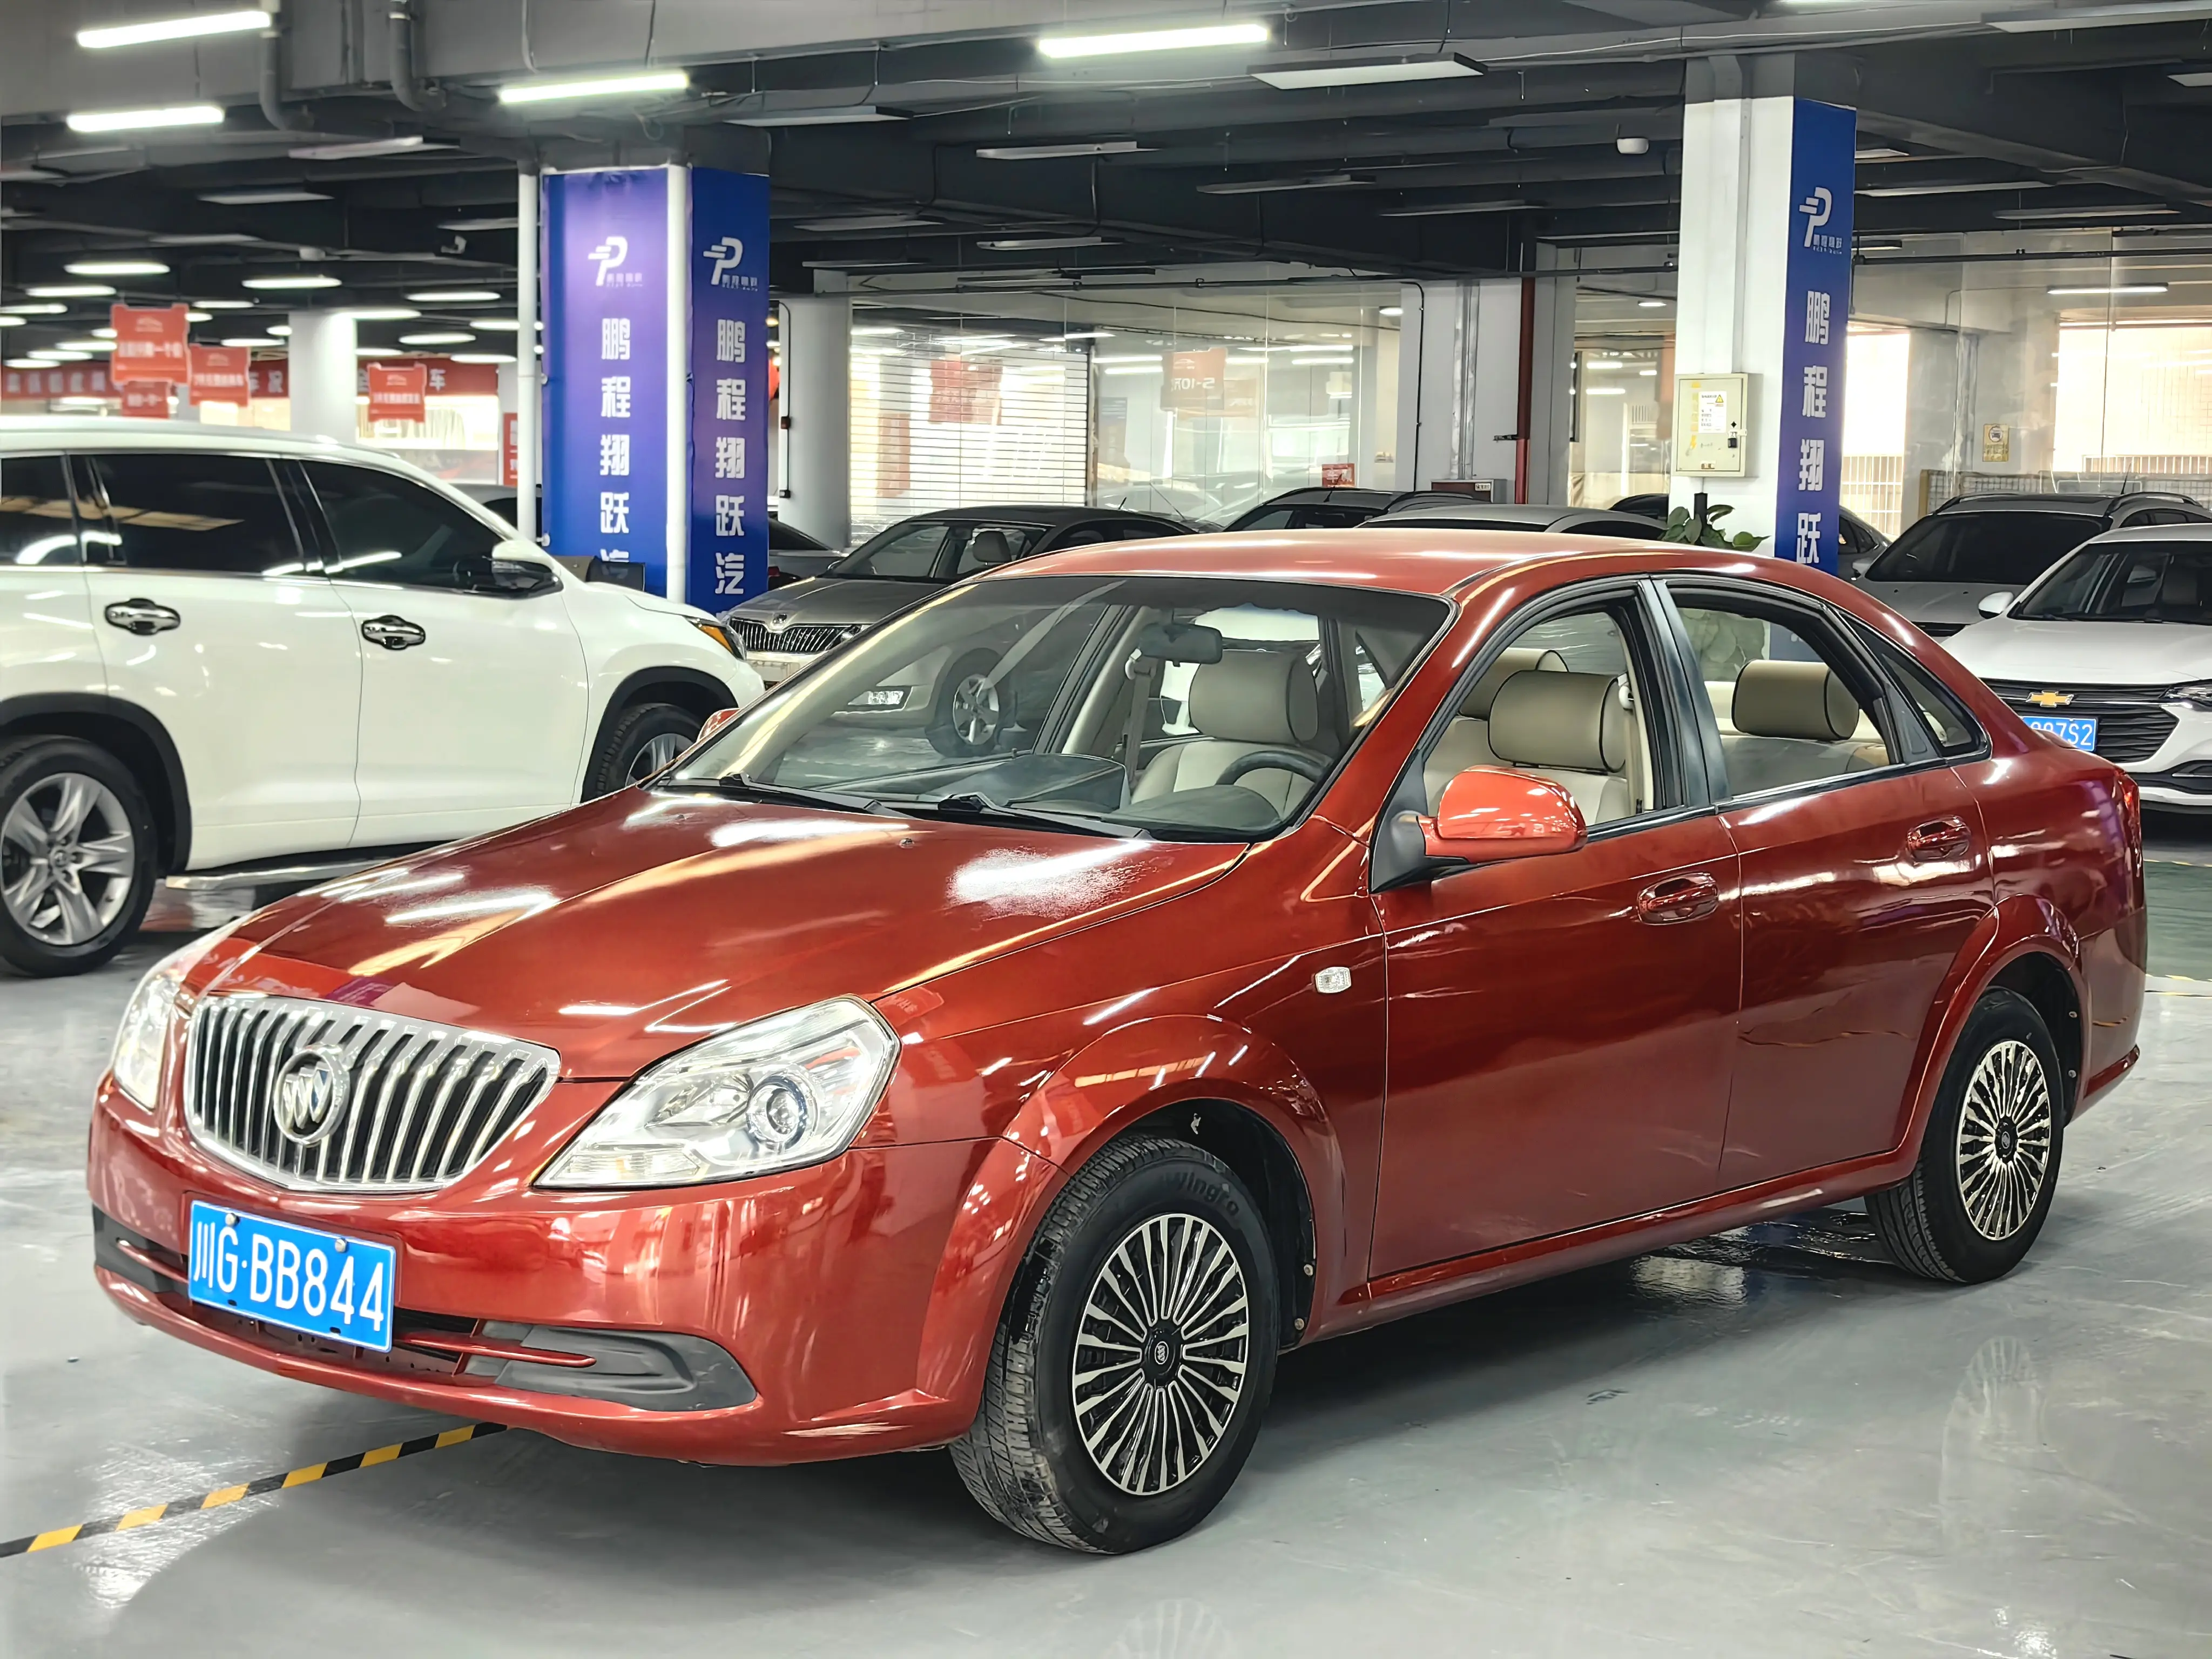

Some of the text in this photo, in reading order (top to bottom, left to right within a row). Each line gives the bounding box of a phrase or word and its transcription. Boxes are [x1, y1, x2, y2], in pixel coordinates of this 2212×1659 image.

[714, 319, 746, 620] 鹏程翔跃汽
[1796, 290, 1830, 563] 鹏程翔跃
